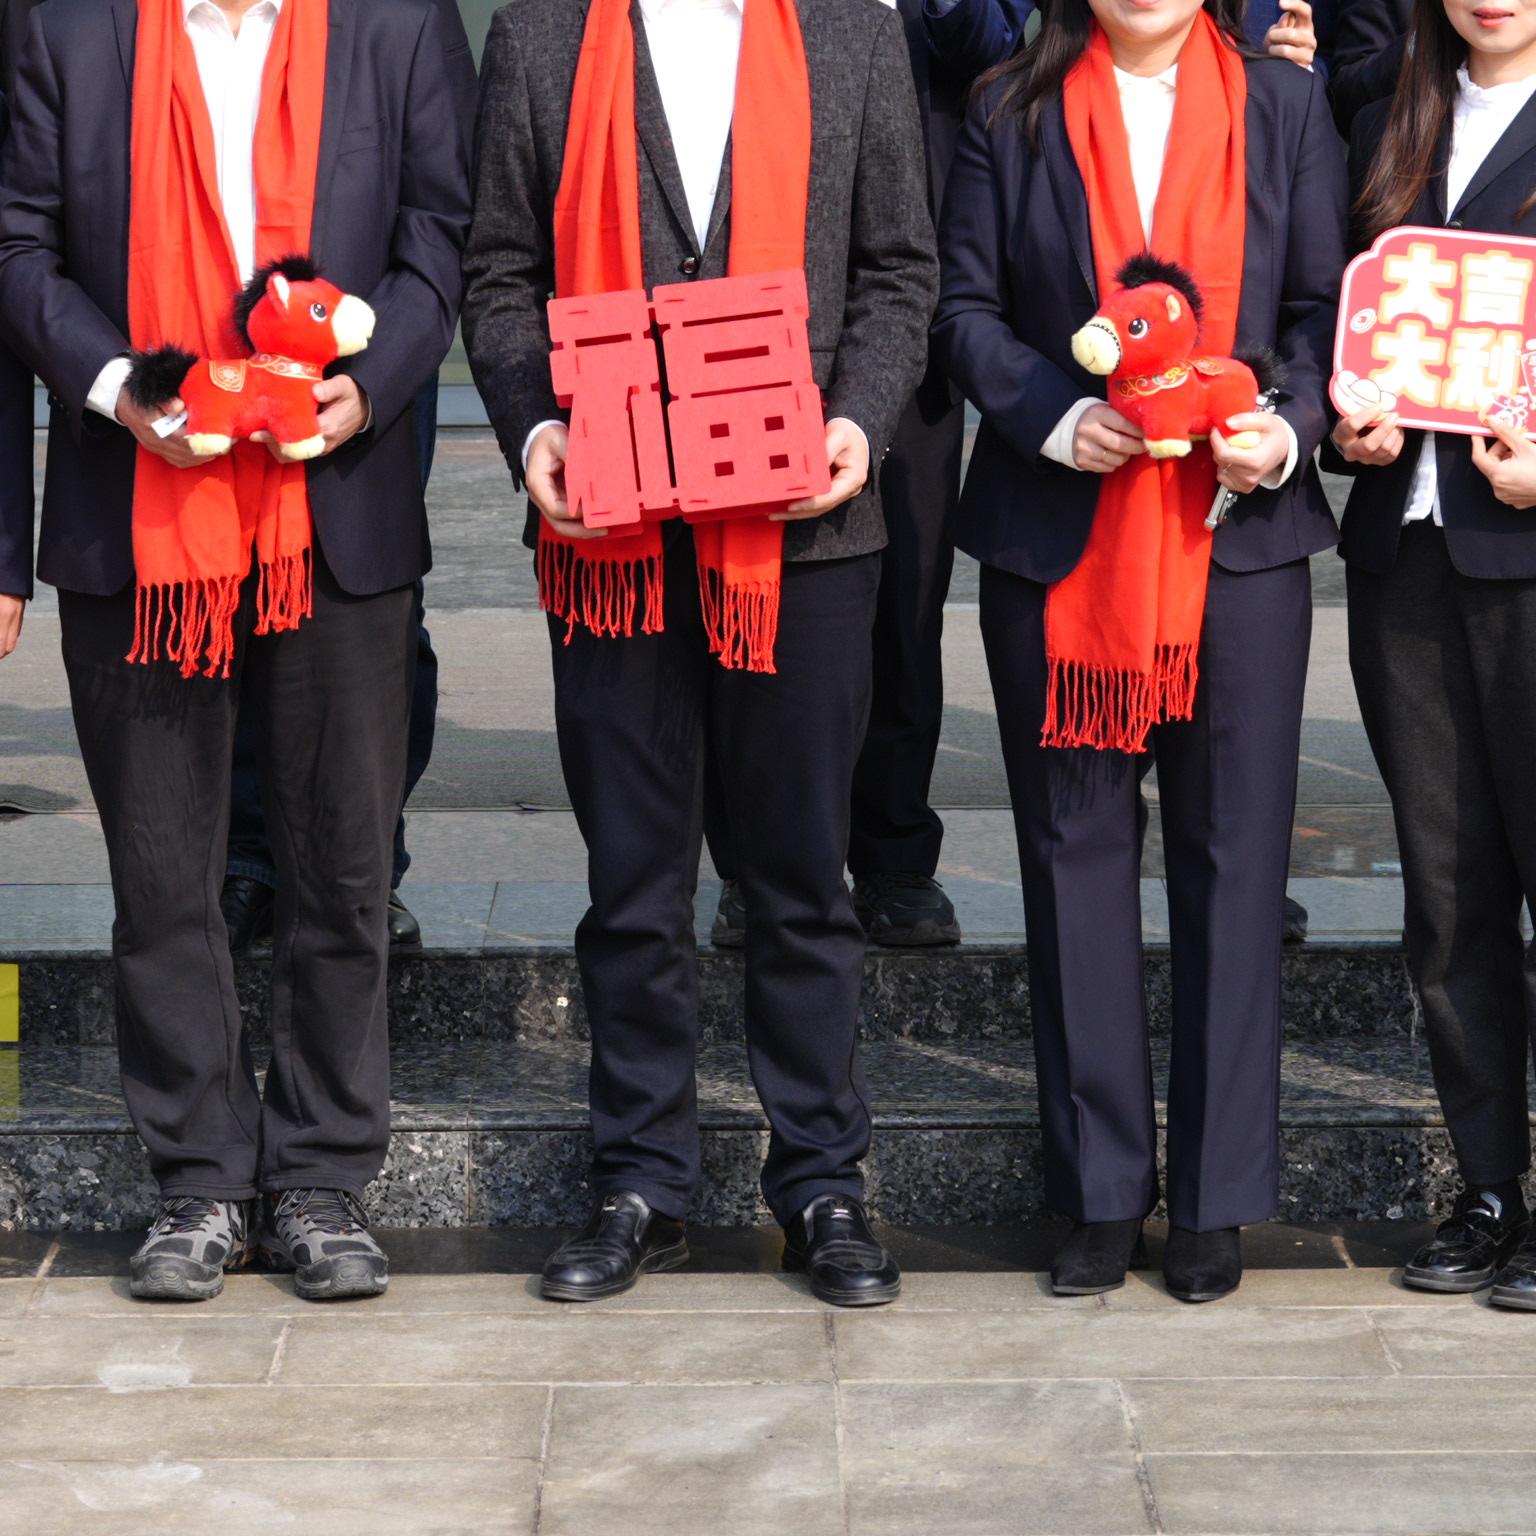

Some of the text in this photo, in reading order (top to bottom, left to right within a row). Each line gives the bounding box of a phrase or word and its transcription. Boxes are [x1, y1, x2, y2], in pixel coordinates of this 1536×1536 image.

[1378, 242, 1534, 329] 大吉
[547, 267, 832, 534] 福
[1368, 319, 1523, 412] 大利
